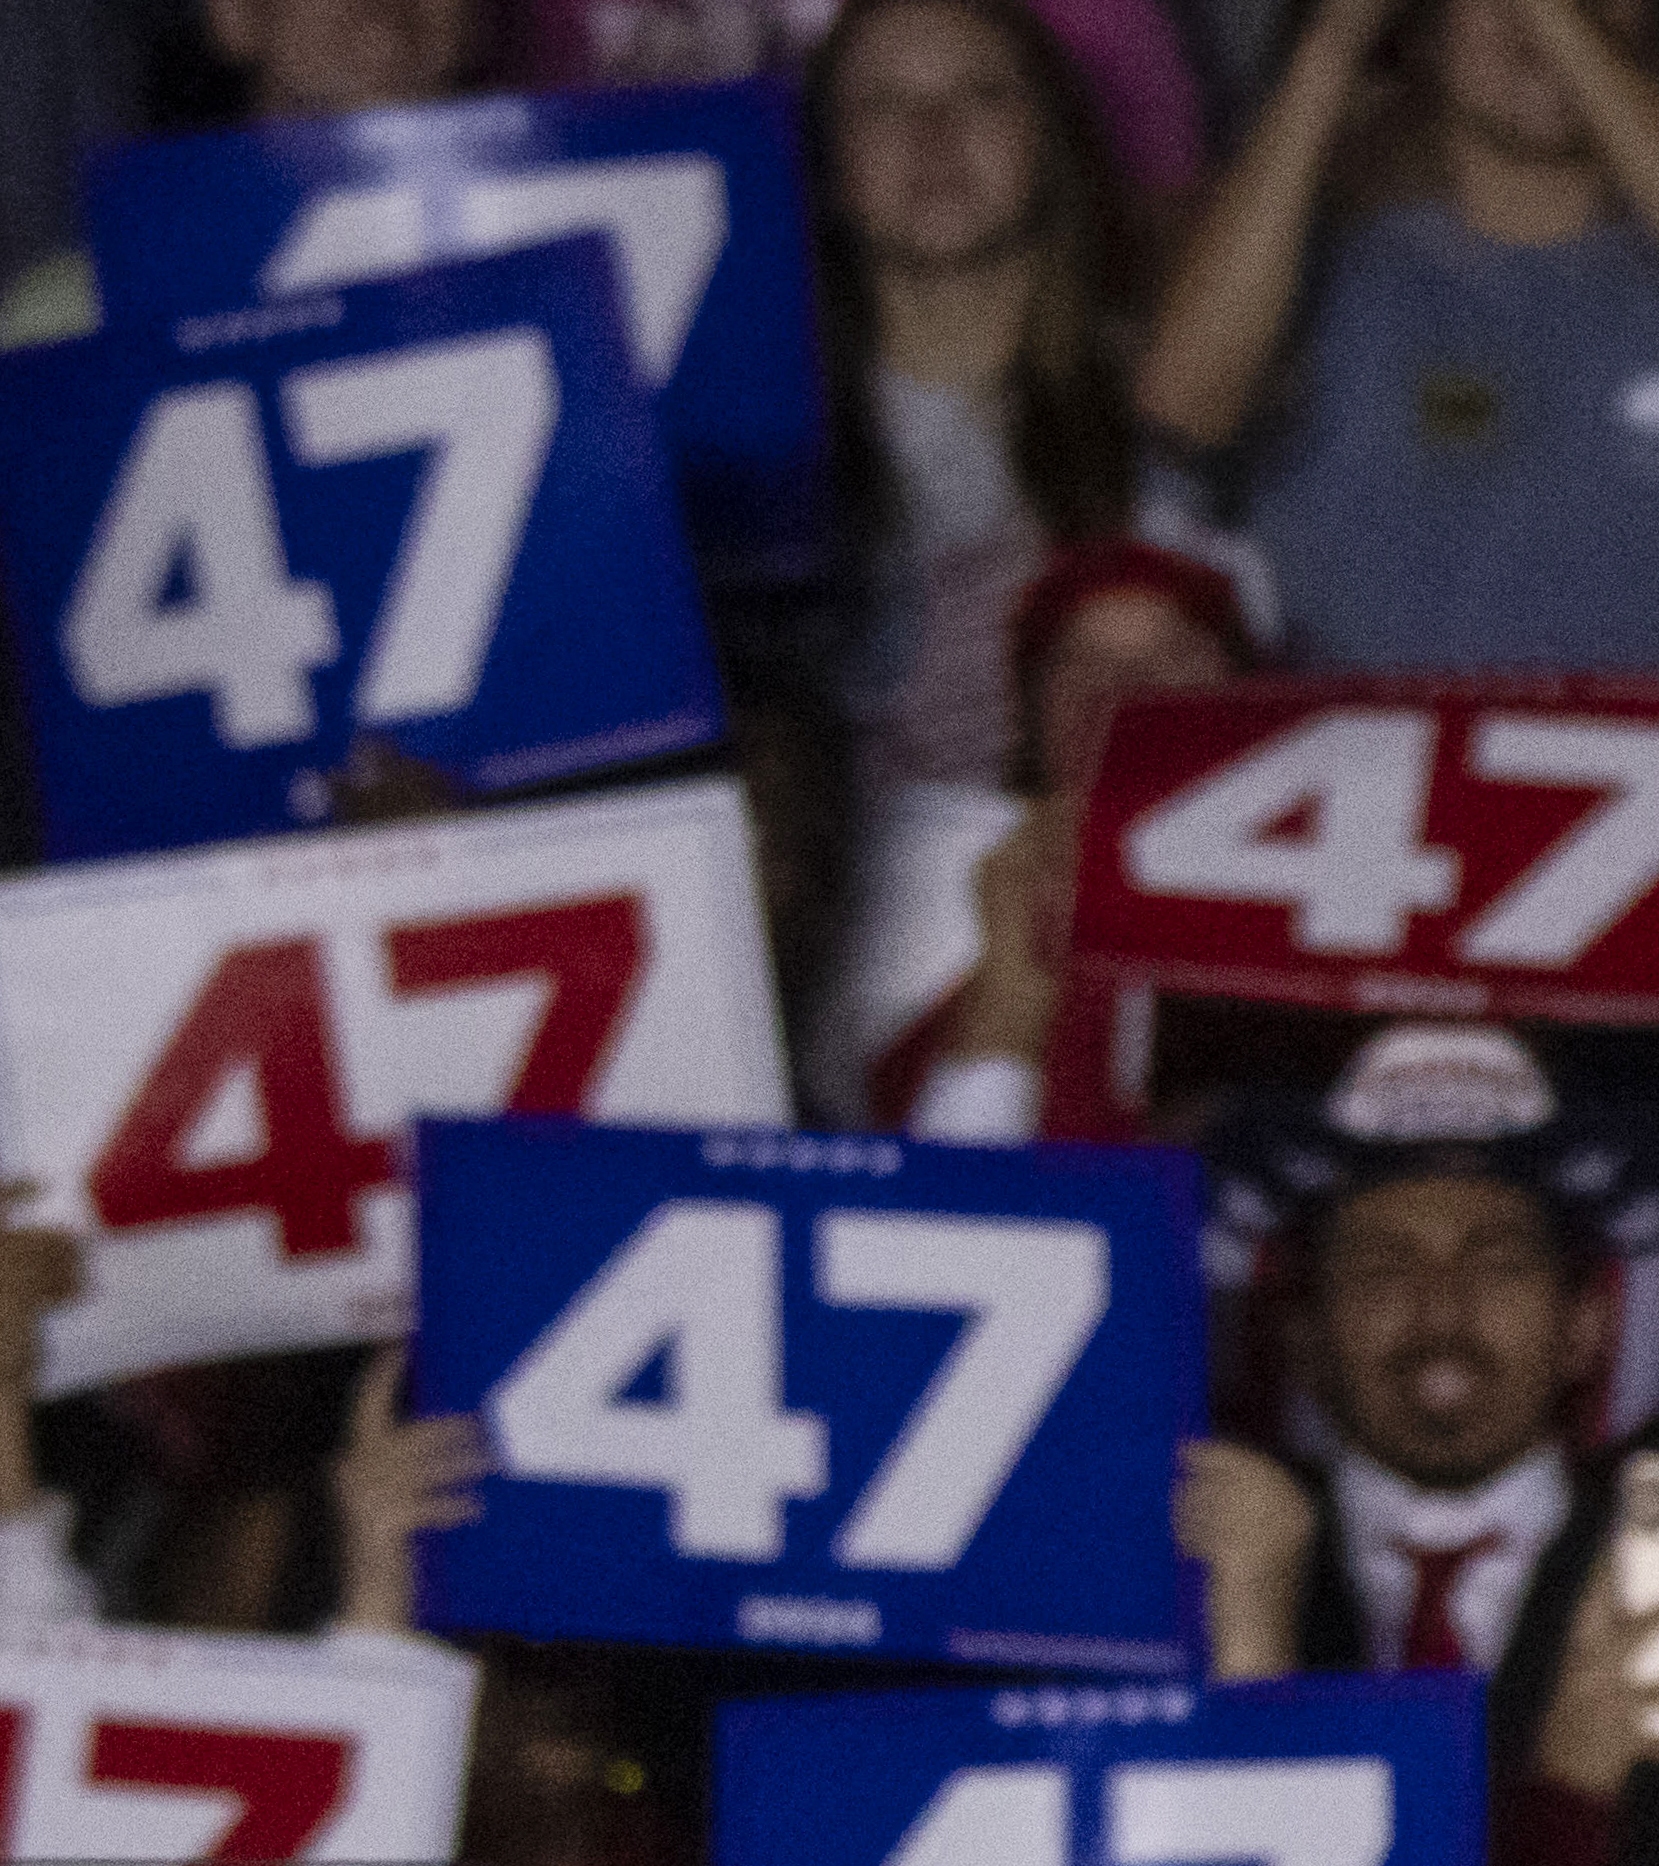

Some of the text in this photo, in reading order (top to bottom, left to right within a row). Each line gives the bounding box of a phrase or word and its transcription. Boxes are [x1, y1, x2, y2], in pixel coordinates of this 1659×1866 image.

[258, 149, 731, 390] 7
[57, 322, 562, 750] 47
[86, 886, 654, 1268] 47
[485, 1199, 1112, 1573] 47
